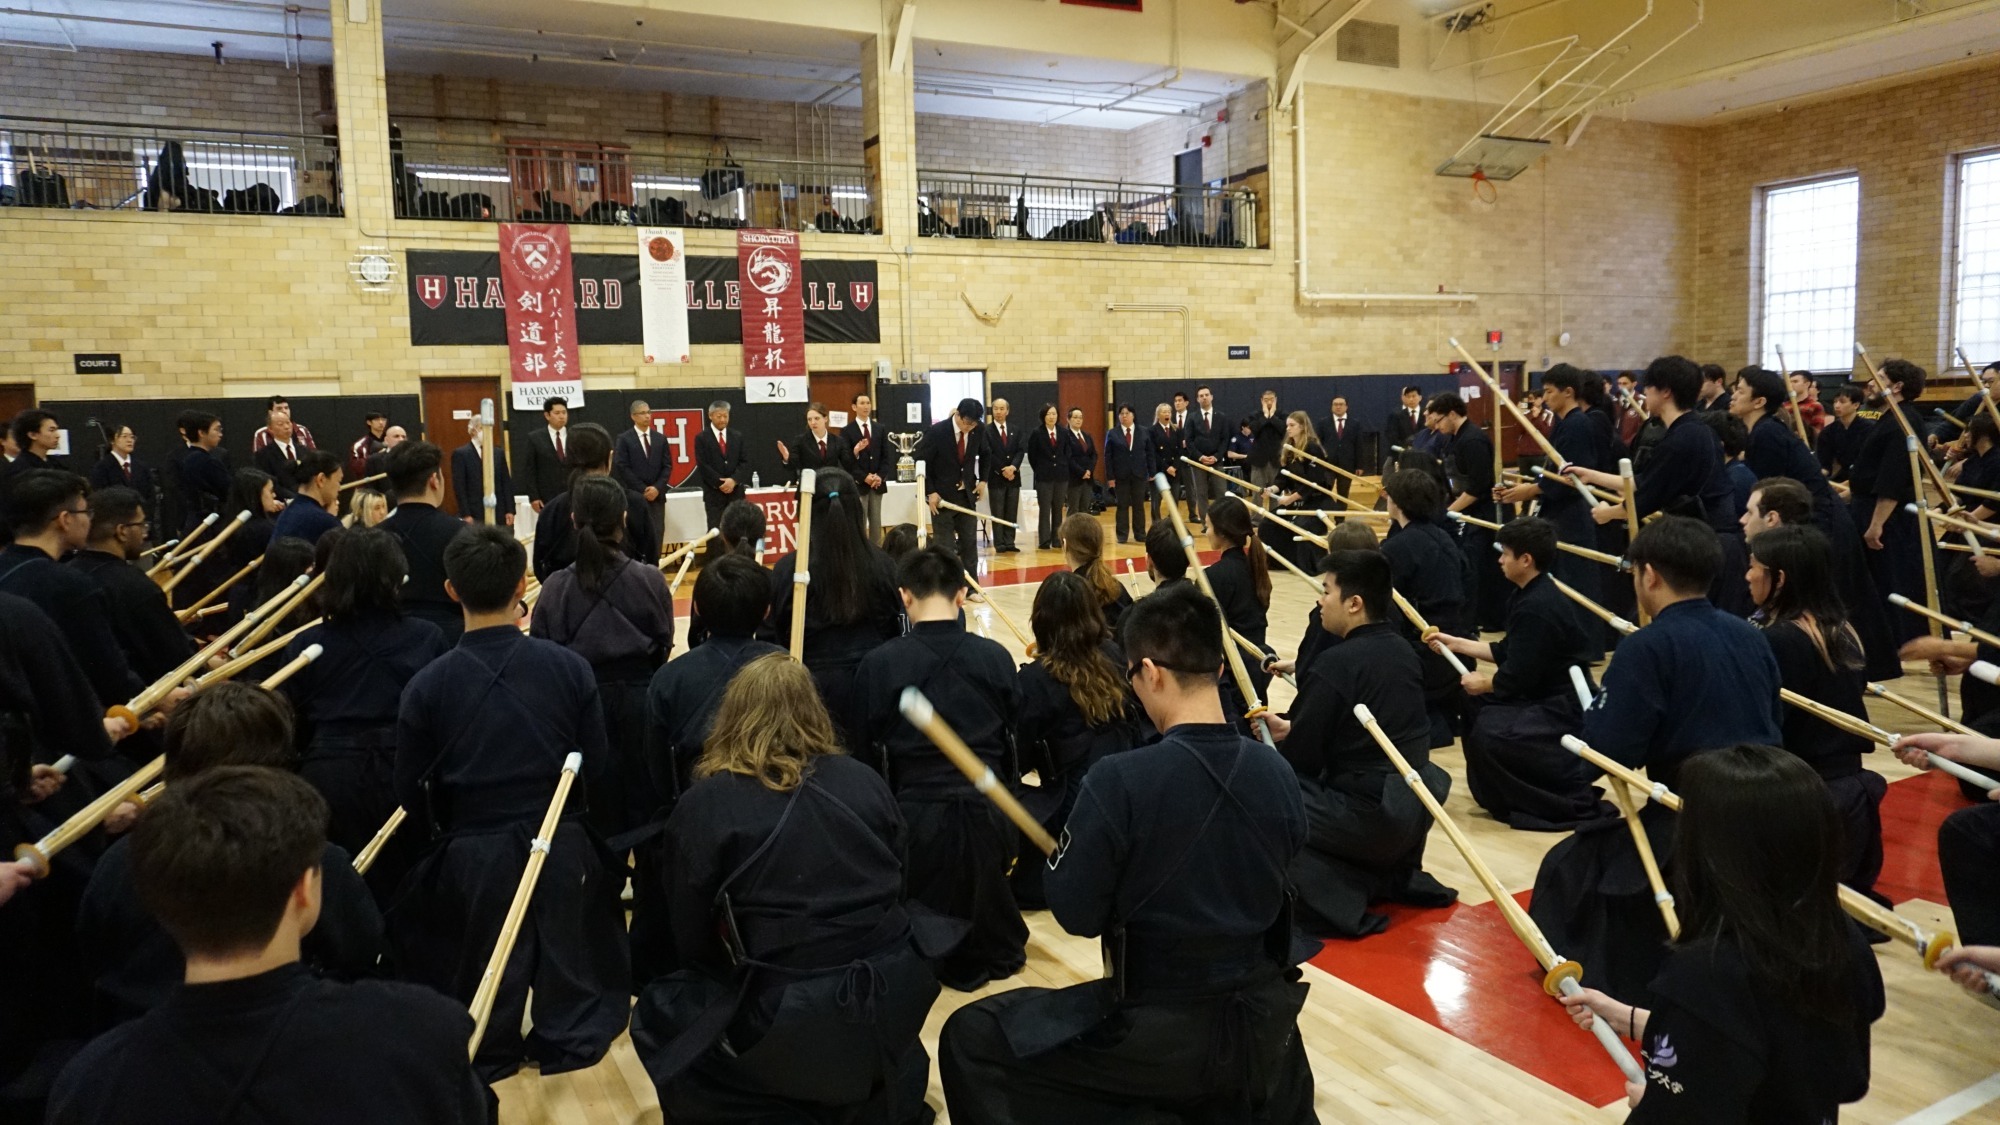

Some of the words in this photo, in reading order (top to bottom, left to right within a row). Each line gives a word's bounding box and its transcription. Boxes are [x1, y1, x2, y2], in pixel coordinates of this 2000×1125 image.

[424, 278, 441, 300] H
[454, 277, 623, 309] HARD
[855, 284, 869, 303] H
[517, 289, 548, 377] 剣道部
[548, 288, 567, 375] ハーバード大学
[762, 297, 786, 370] 昇龍杯
[79, 360, 110, 368] COURT
[110, 360, 118, 368] 2
[519, 385, 575, 396] HARVARD
[766, 380, 786, 398] 26
